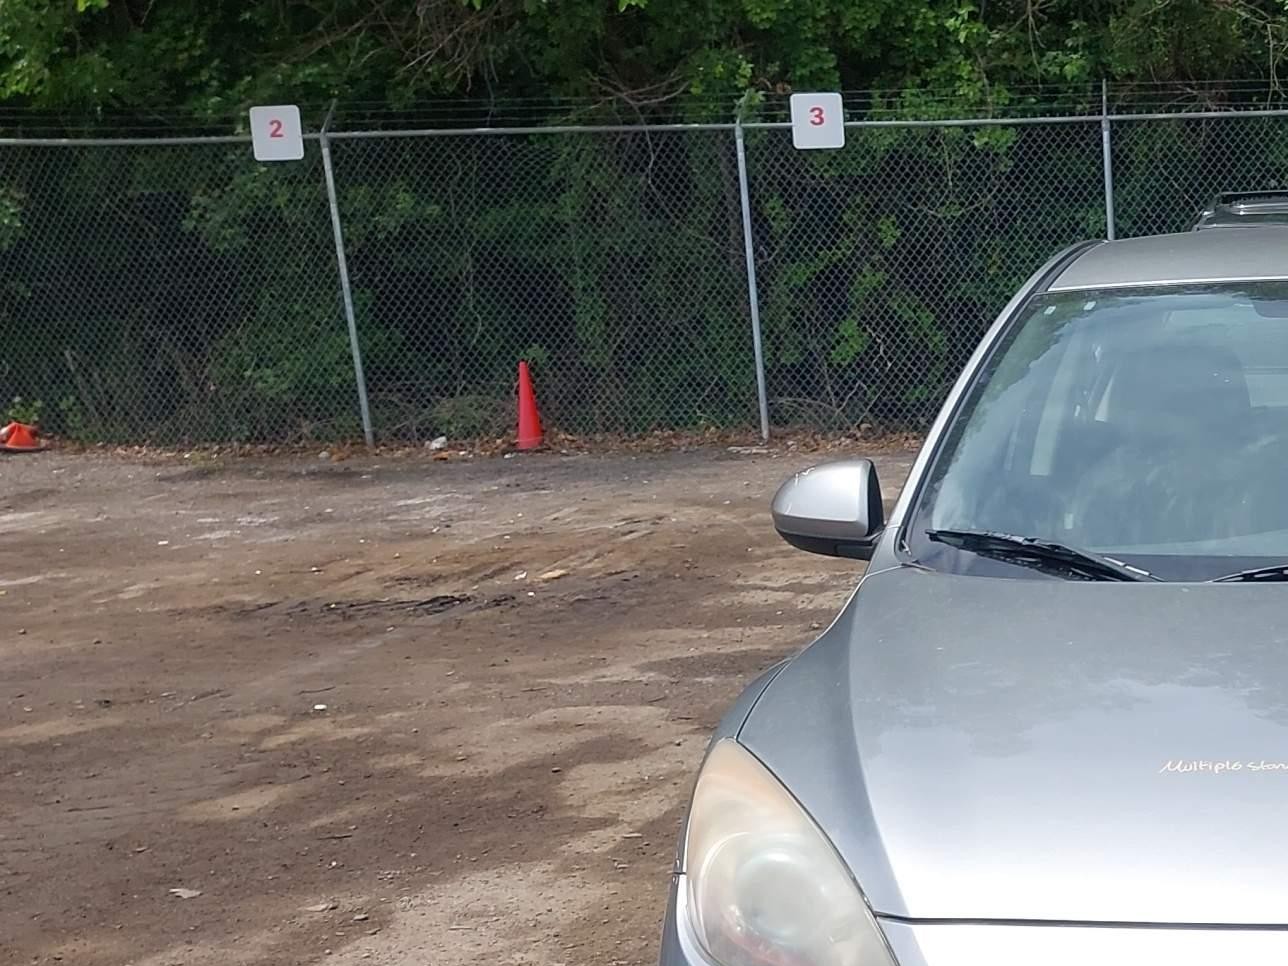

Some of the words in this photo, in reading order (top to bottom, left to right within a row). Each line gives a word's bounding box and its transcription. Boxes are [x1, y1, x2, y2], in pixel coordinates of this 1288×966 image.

[810, 107, 824, 125] 3
[269, 120, 283, 138] 2
[1159, 760, 1243, 774] Multiple
